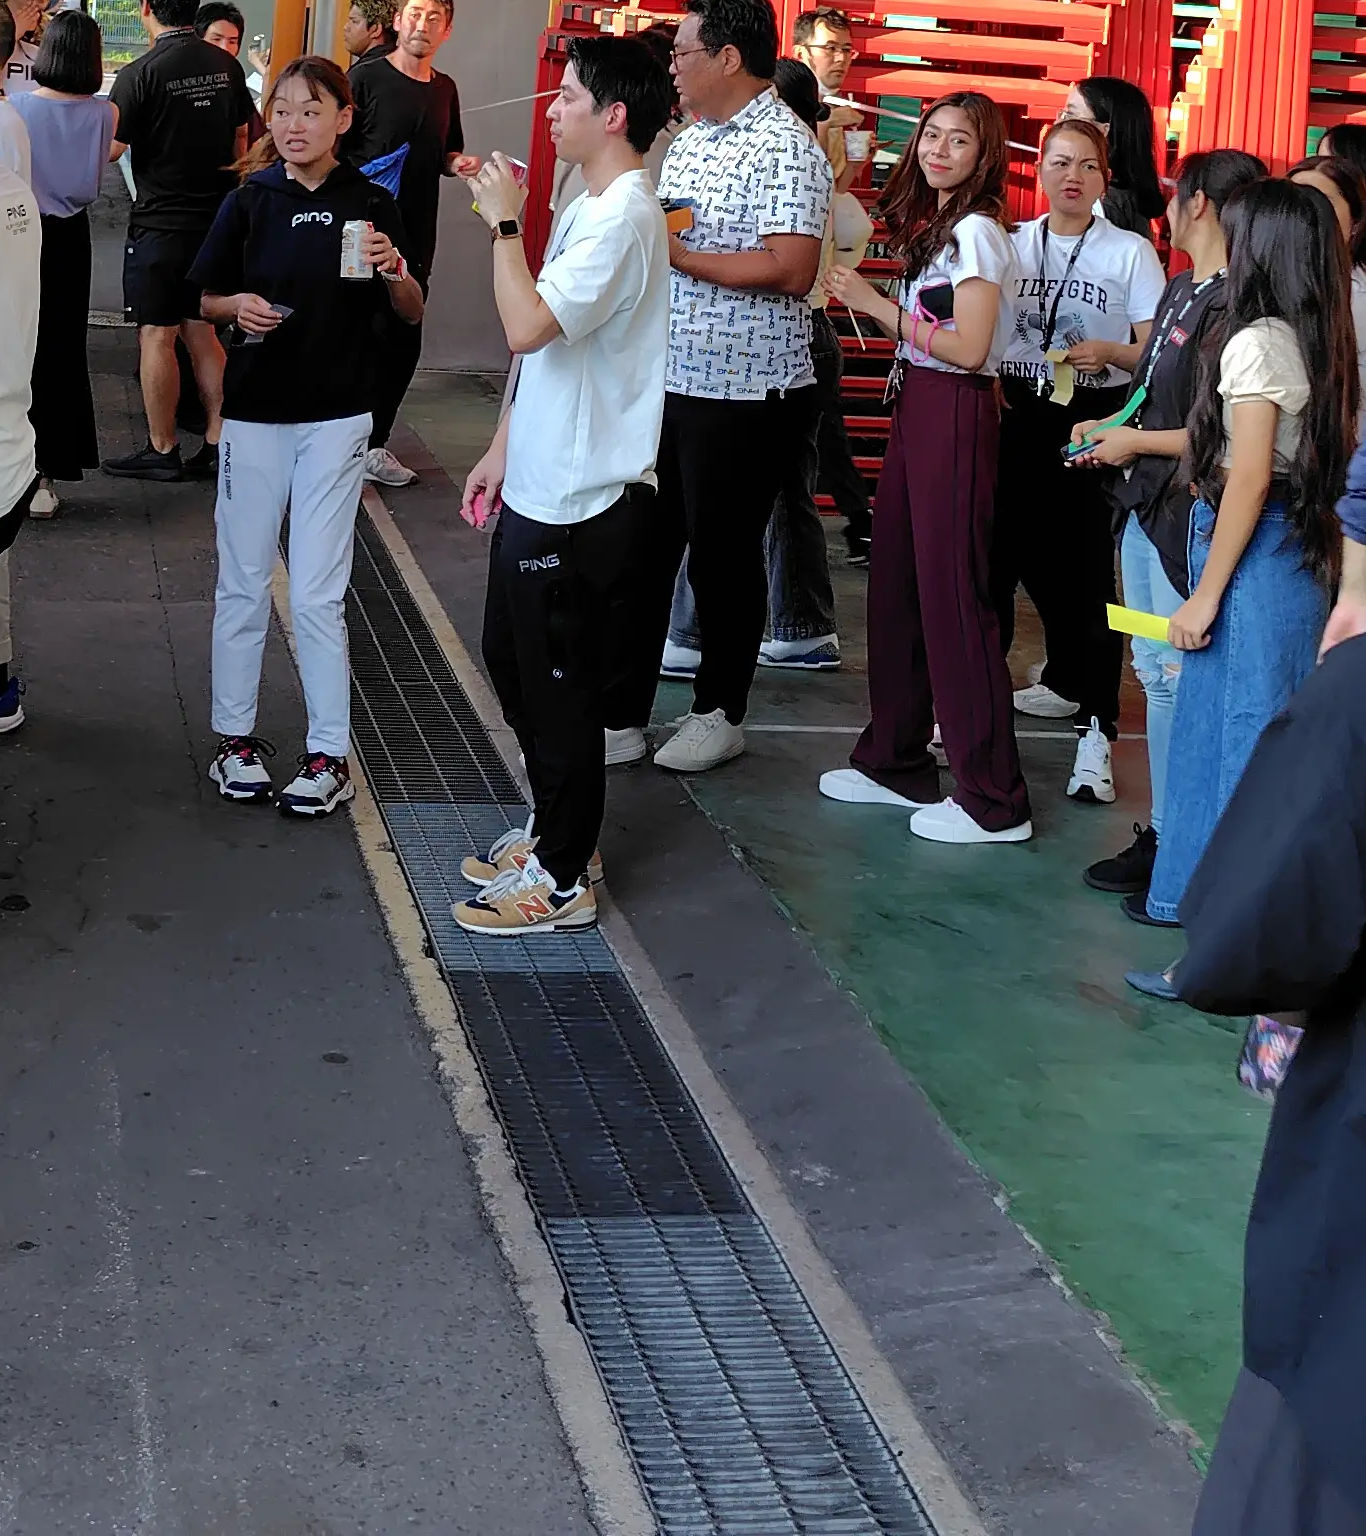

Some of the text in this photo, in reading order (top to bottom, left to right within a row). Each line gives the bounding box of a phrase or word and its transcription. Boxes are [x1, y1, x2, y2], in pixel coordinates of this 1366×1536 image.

[6, 204, 26, 221] PING
[291, 211, 333, 227] ping
[223, 441, 232, 474] PING
[519, 553, 560, 572] PING
